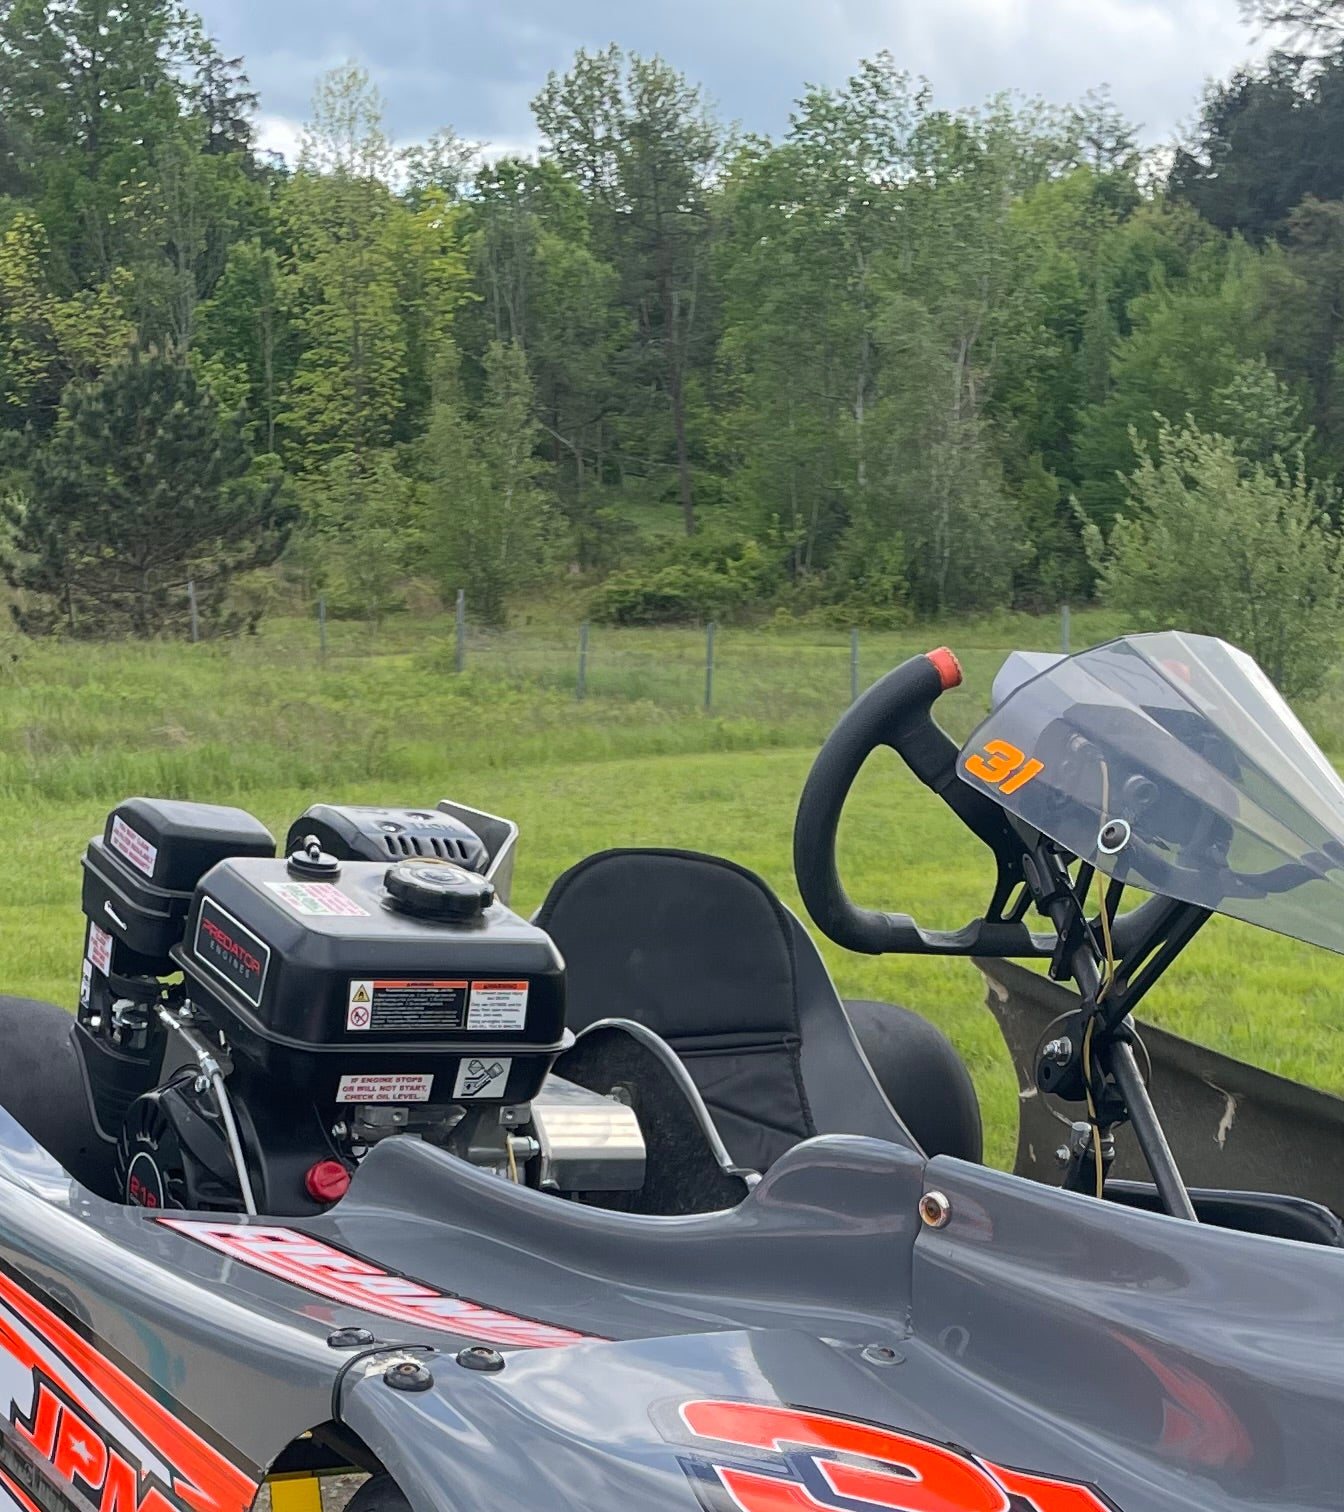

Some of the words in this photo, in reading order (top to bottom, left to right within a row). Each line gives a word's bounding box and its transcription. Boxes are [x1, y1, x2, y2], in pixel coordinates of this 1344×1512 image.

[964, 739, 1044, 795] 31
[202, 918, 261, 976] PREDATOR
[210, 940, 250, 979] ENGINES
